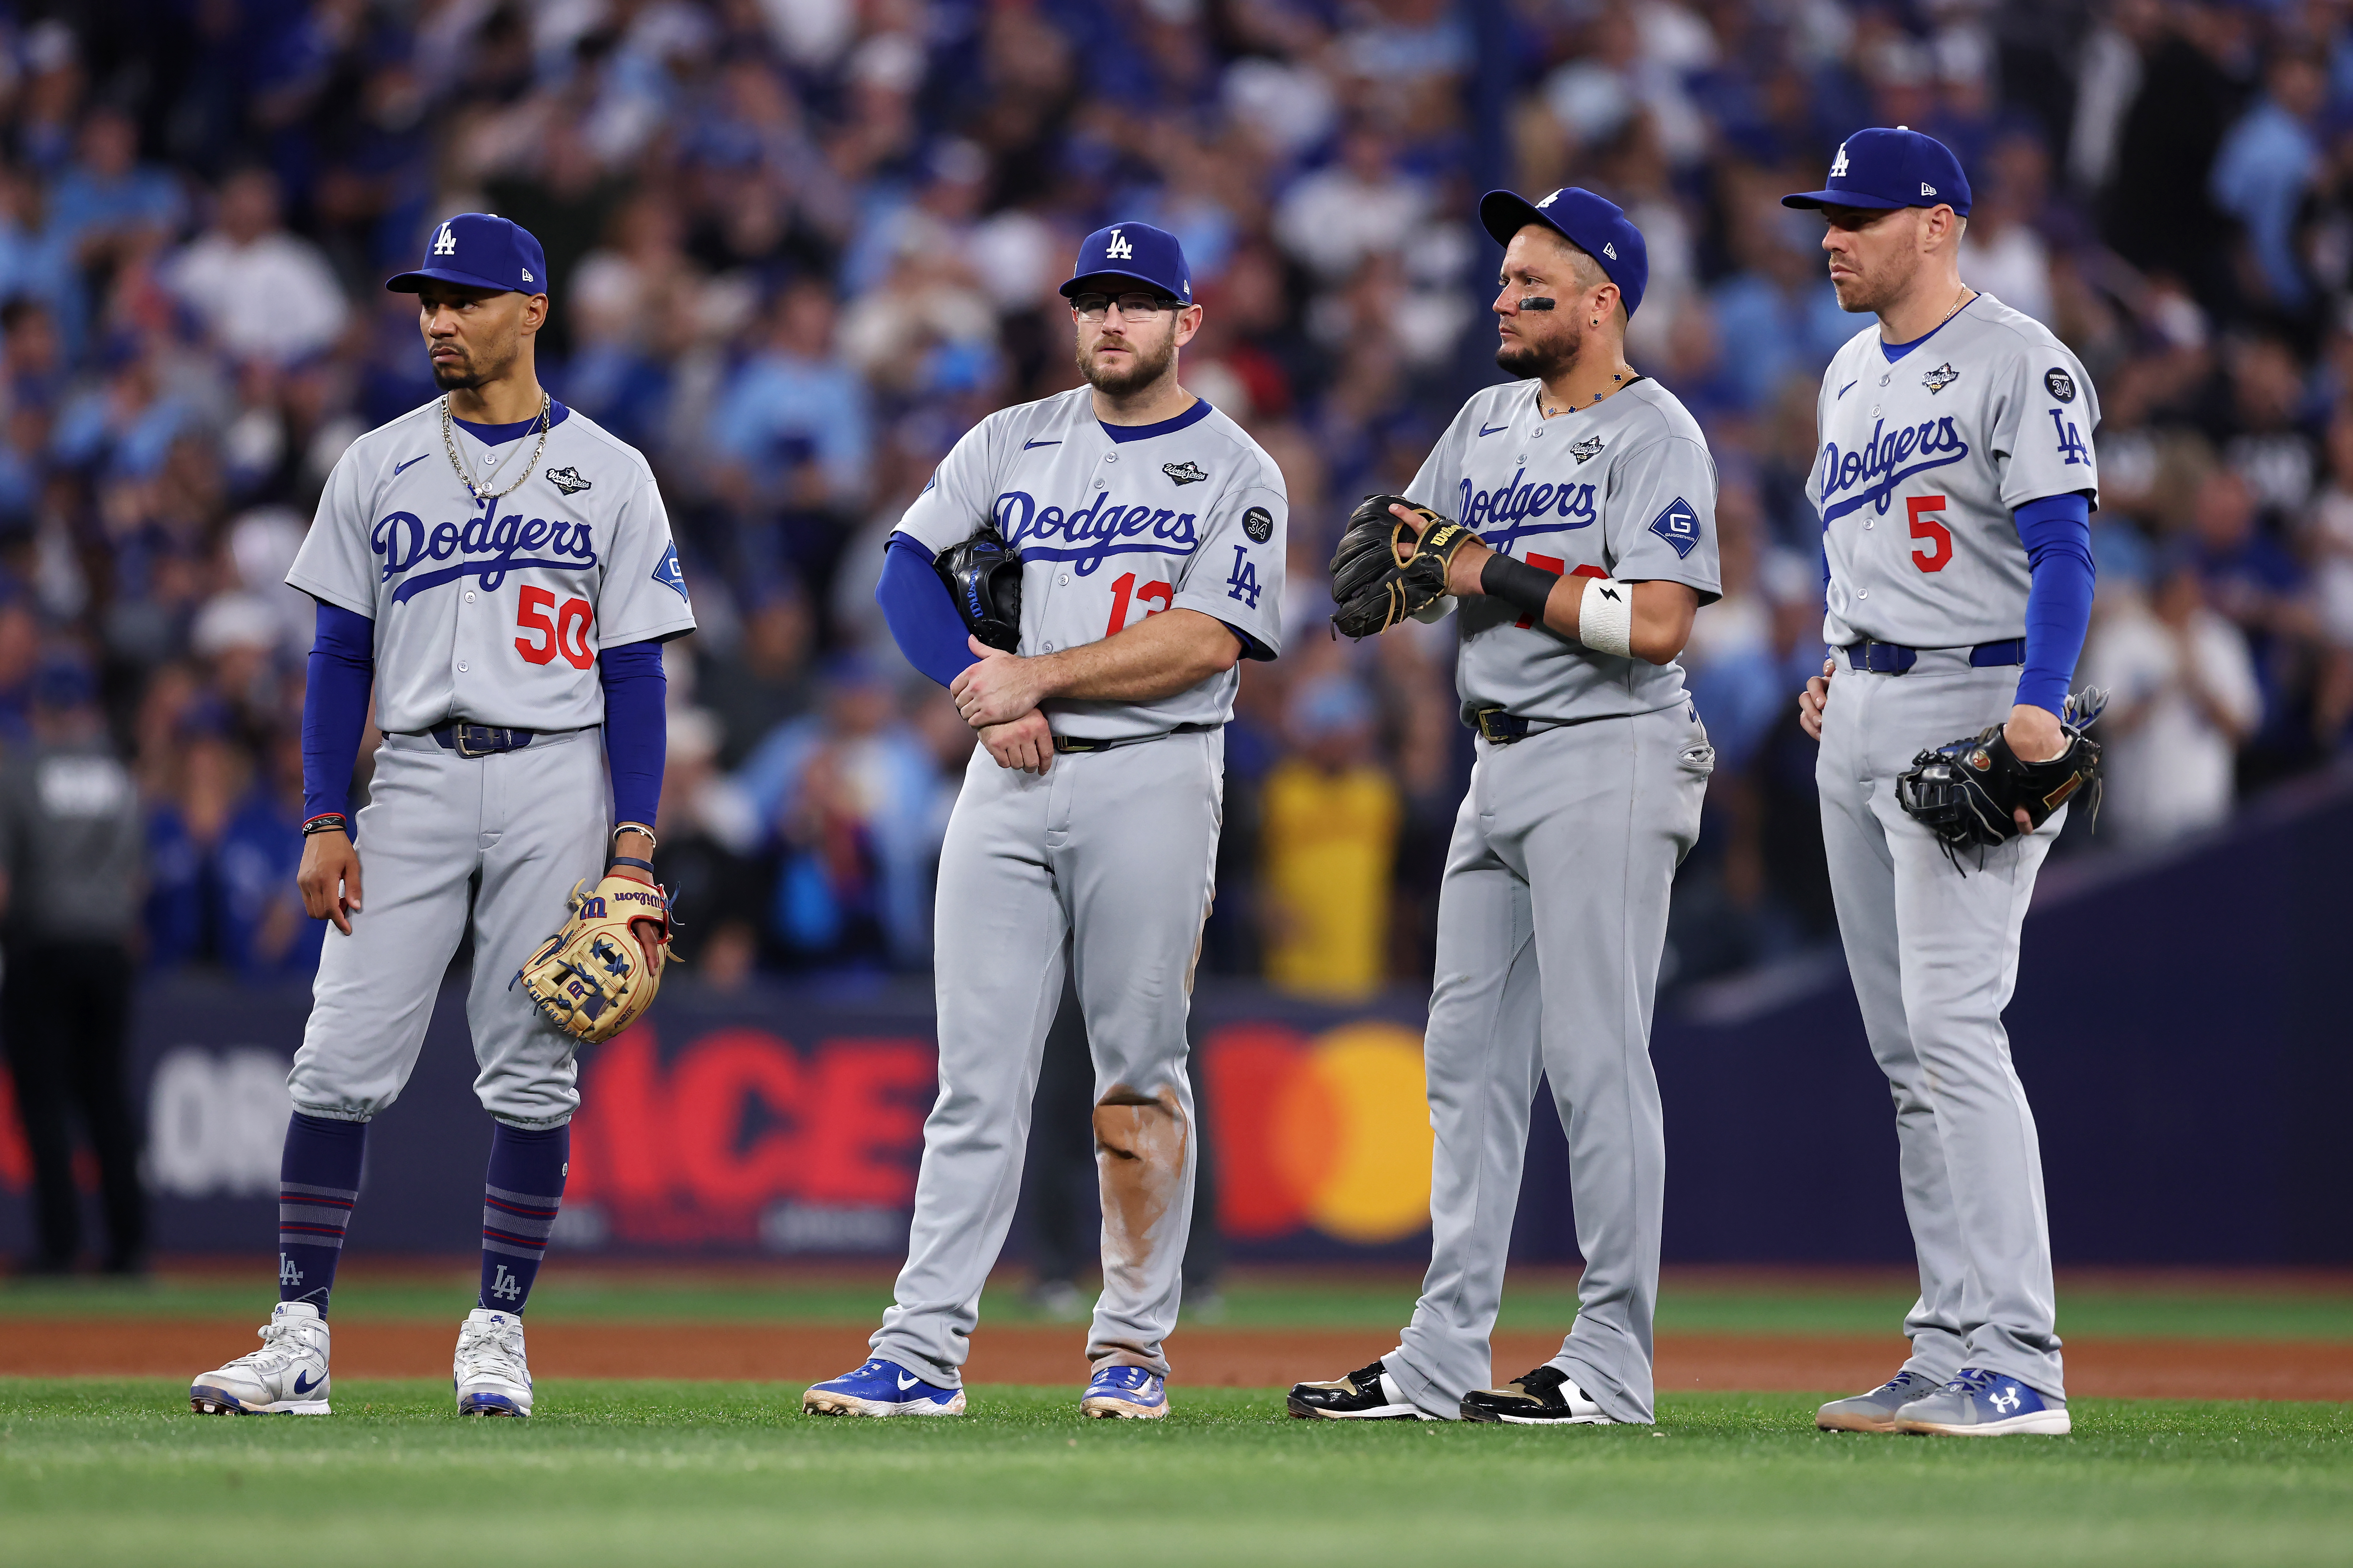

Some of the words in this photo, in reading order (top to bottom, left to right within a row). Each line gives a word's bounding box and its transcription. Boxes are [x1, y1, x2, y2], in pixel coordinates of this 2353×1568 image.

[1830, 142, 1850, 178] LA
[434, 222, 457, 255] LA
[1106, 229, 1132, 260] LA
[2052, 380, 2071, 398] 34
[2048, 408, 2091, 467] LA
[548, 469, 572, 484] World
[566, 477, 589, 488] Series
[1164, 464, 1189, 476] World
[1181, 470, 1205, 480] Series
[1820, 416, 1969, 516] Dodgers
[1250, 511, 1270, 524] FERNANDO
[1459, 467, 1597, 555] Dodgers
[1669, 513, 1691, 533] G
[371, 497, 598, 592] Dodgers
[993, 492, 1200, 576] Dodgers
[1248, 518, 1267, 539] 34
[1665, 533, 1695, 542] GUGGENHEIM
[1906, 495, 1953, 573] 5
[967, 565, 983, 618] Wilson
[1226, 544, 1262, 610] LA
[514, 584, 595, 670] 50
[614, 892, 661, 909] Wilson
[614, 1005, 636, 1029] A2K
[279, 1252, 303, 1286] LA
[491, 1264, 521, 1301] LA
